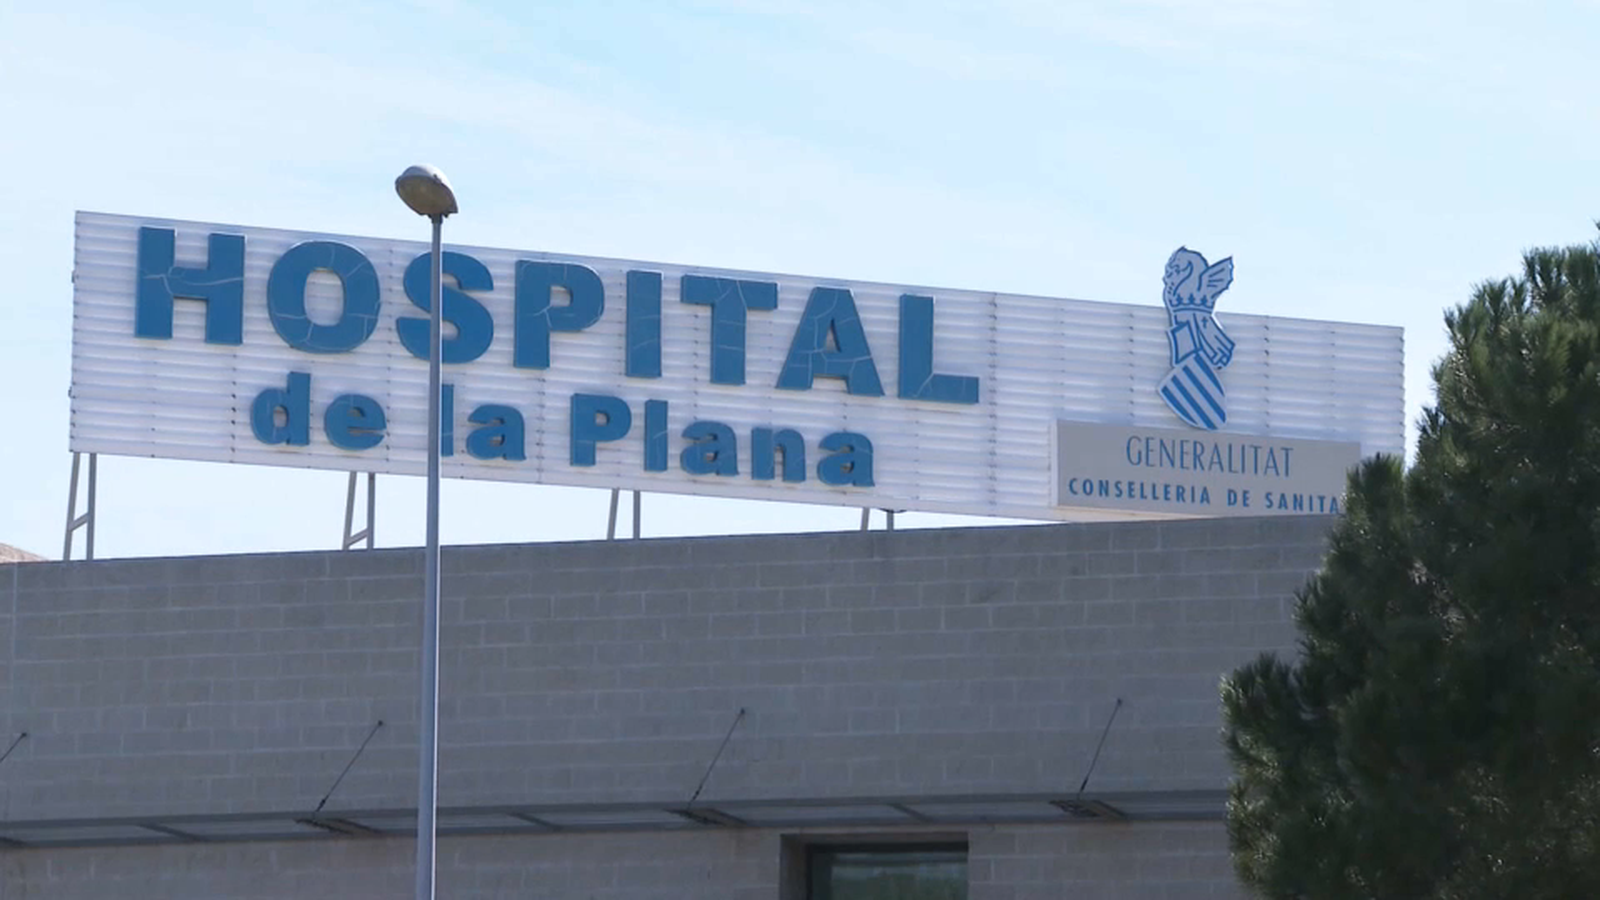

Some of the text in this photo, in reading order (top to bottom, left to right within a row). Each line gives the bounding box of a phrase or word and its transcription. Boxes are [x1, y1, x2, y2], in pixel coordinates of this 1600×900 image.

[135, 226, 979, 404] HOSPITAL
[250, 371, 875, 487] de la Plana
[1126, 435, 1294, 478] GENERALITAT
[1068, 477, 1211, 505] CONSELLERIA
[1227, 489, 1251, 508] DE
